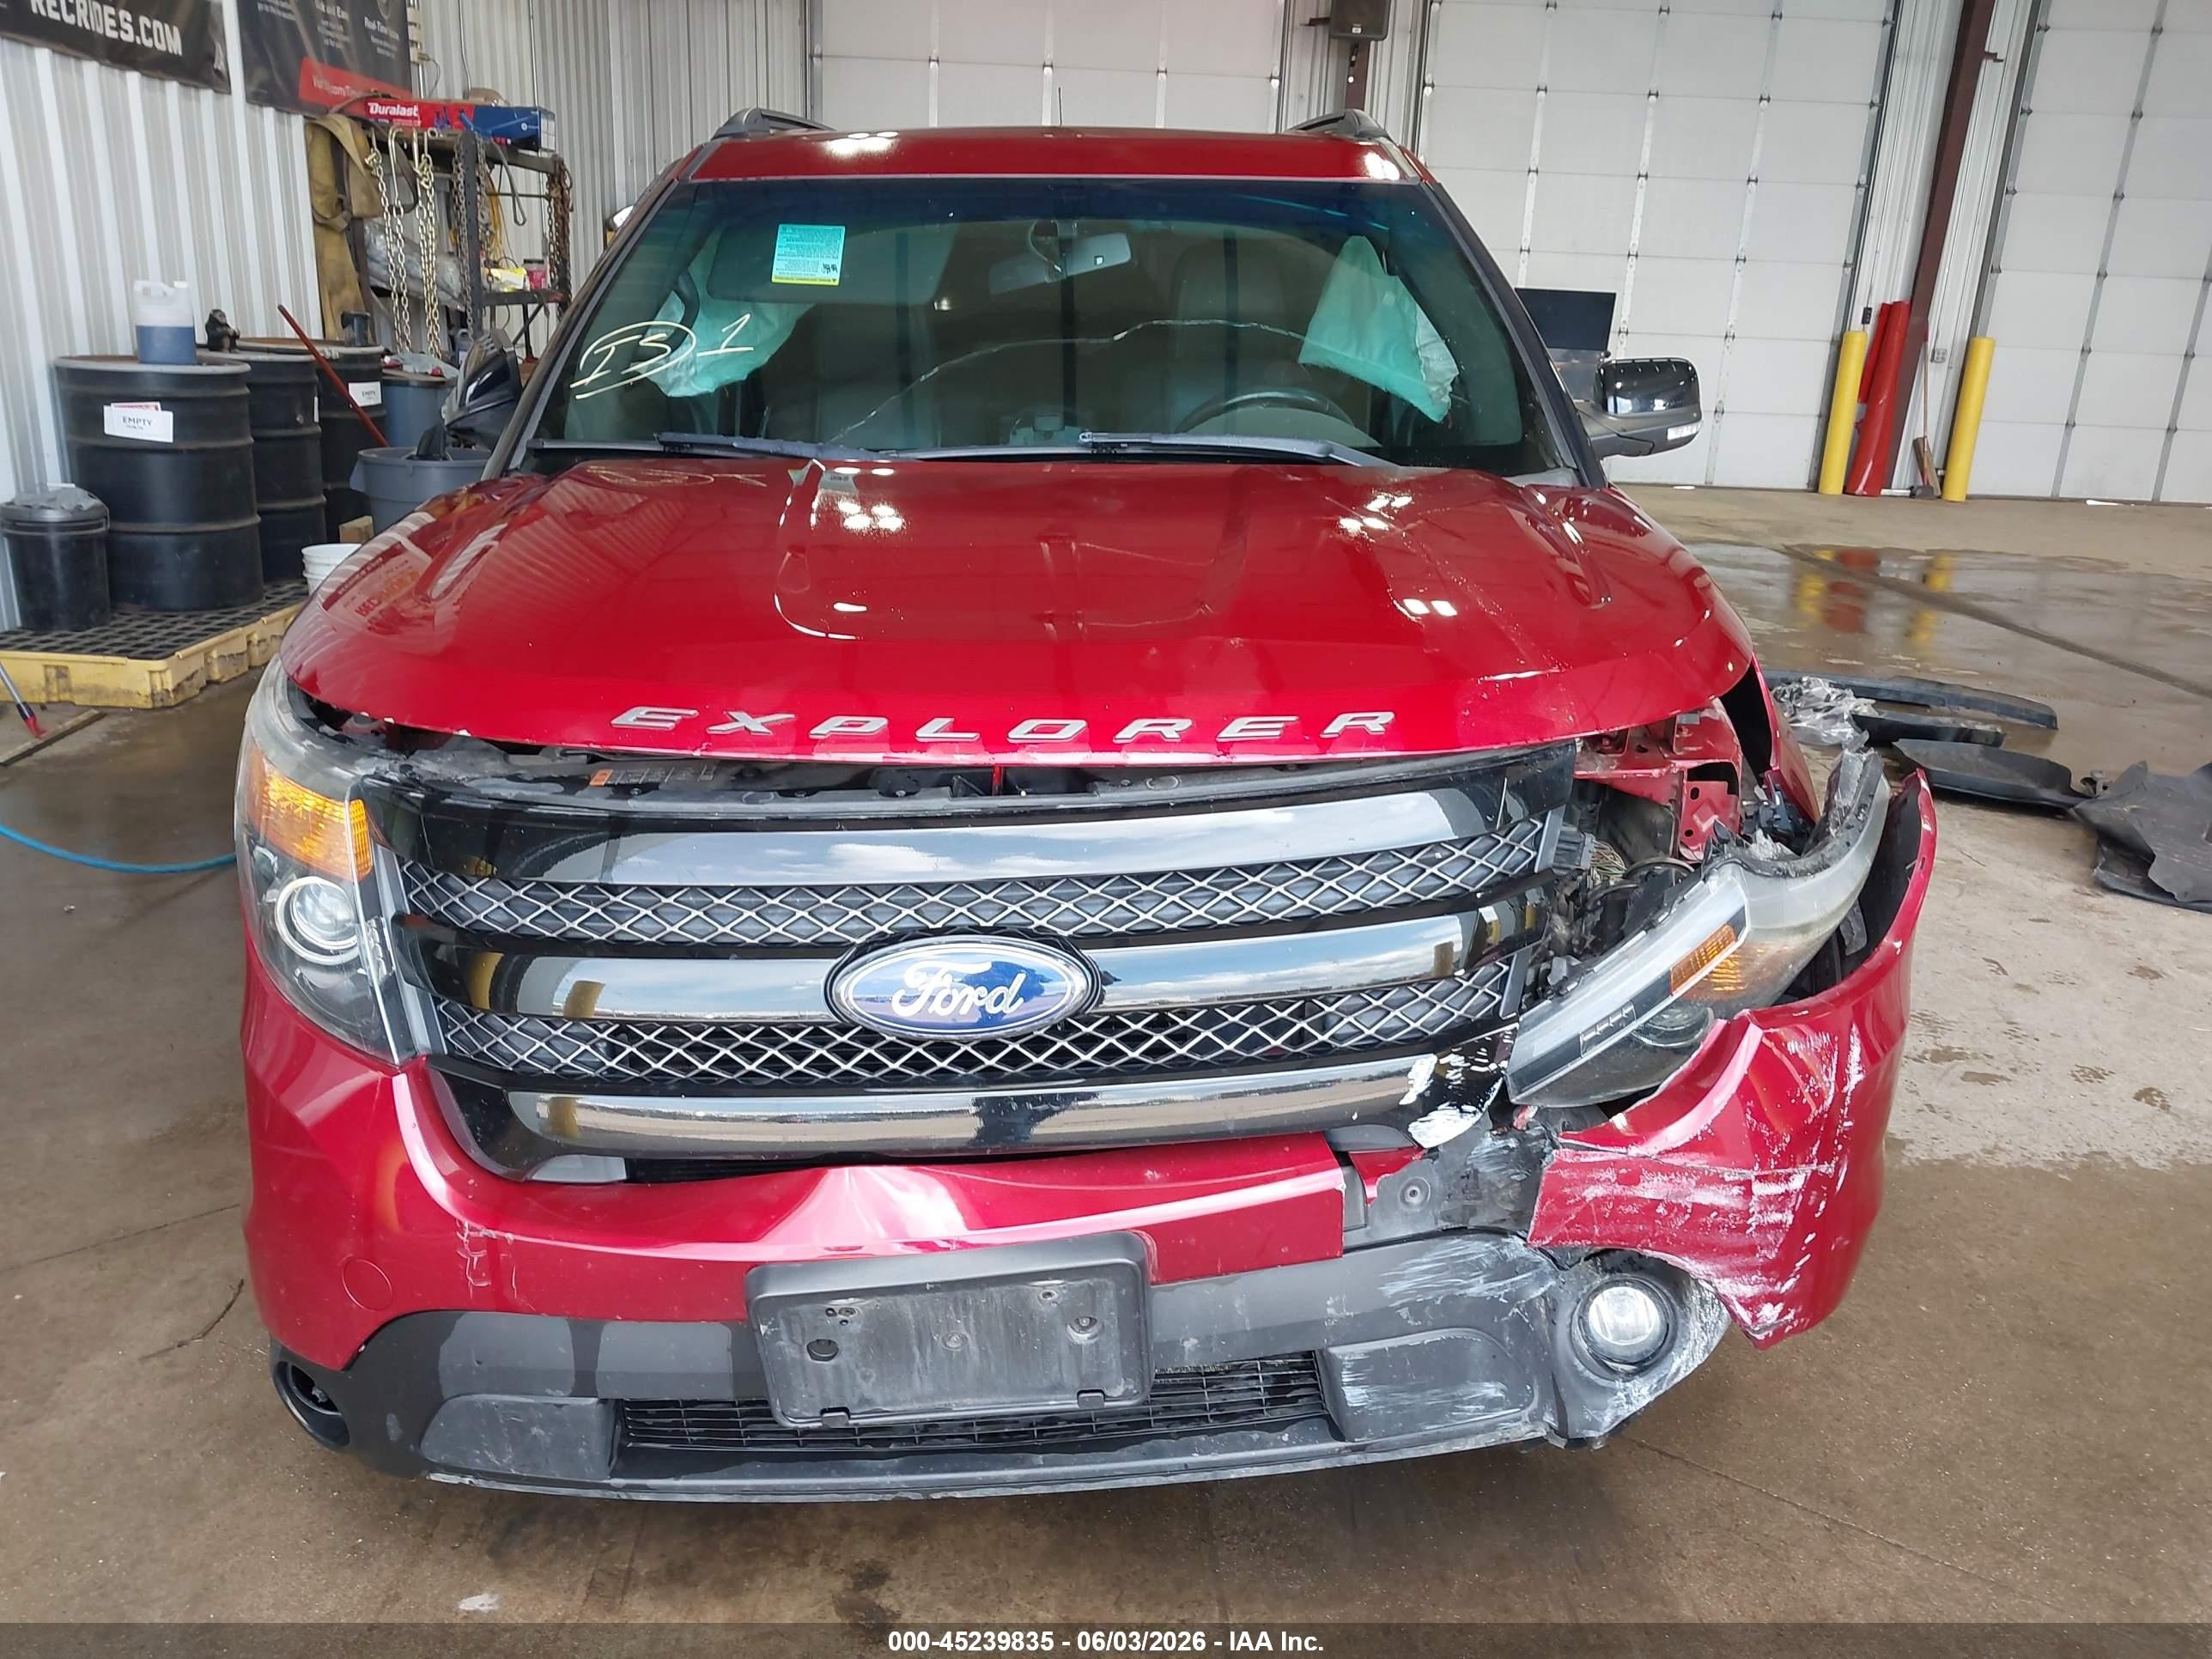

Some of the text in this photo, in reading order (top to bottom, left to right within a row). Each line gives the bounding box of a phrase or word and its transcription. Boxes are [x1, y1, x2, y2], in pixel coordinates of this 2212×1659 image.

[367, 102, 419, 117] Duralast
[122, 416, 153, 427] EMPTY
[611, 705, 1395, 744] EXPLORER
[890, 960, 1027, 1018] Ford
